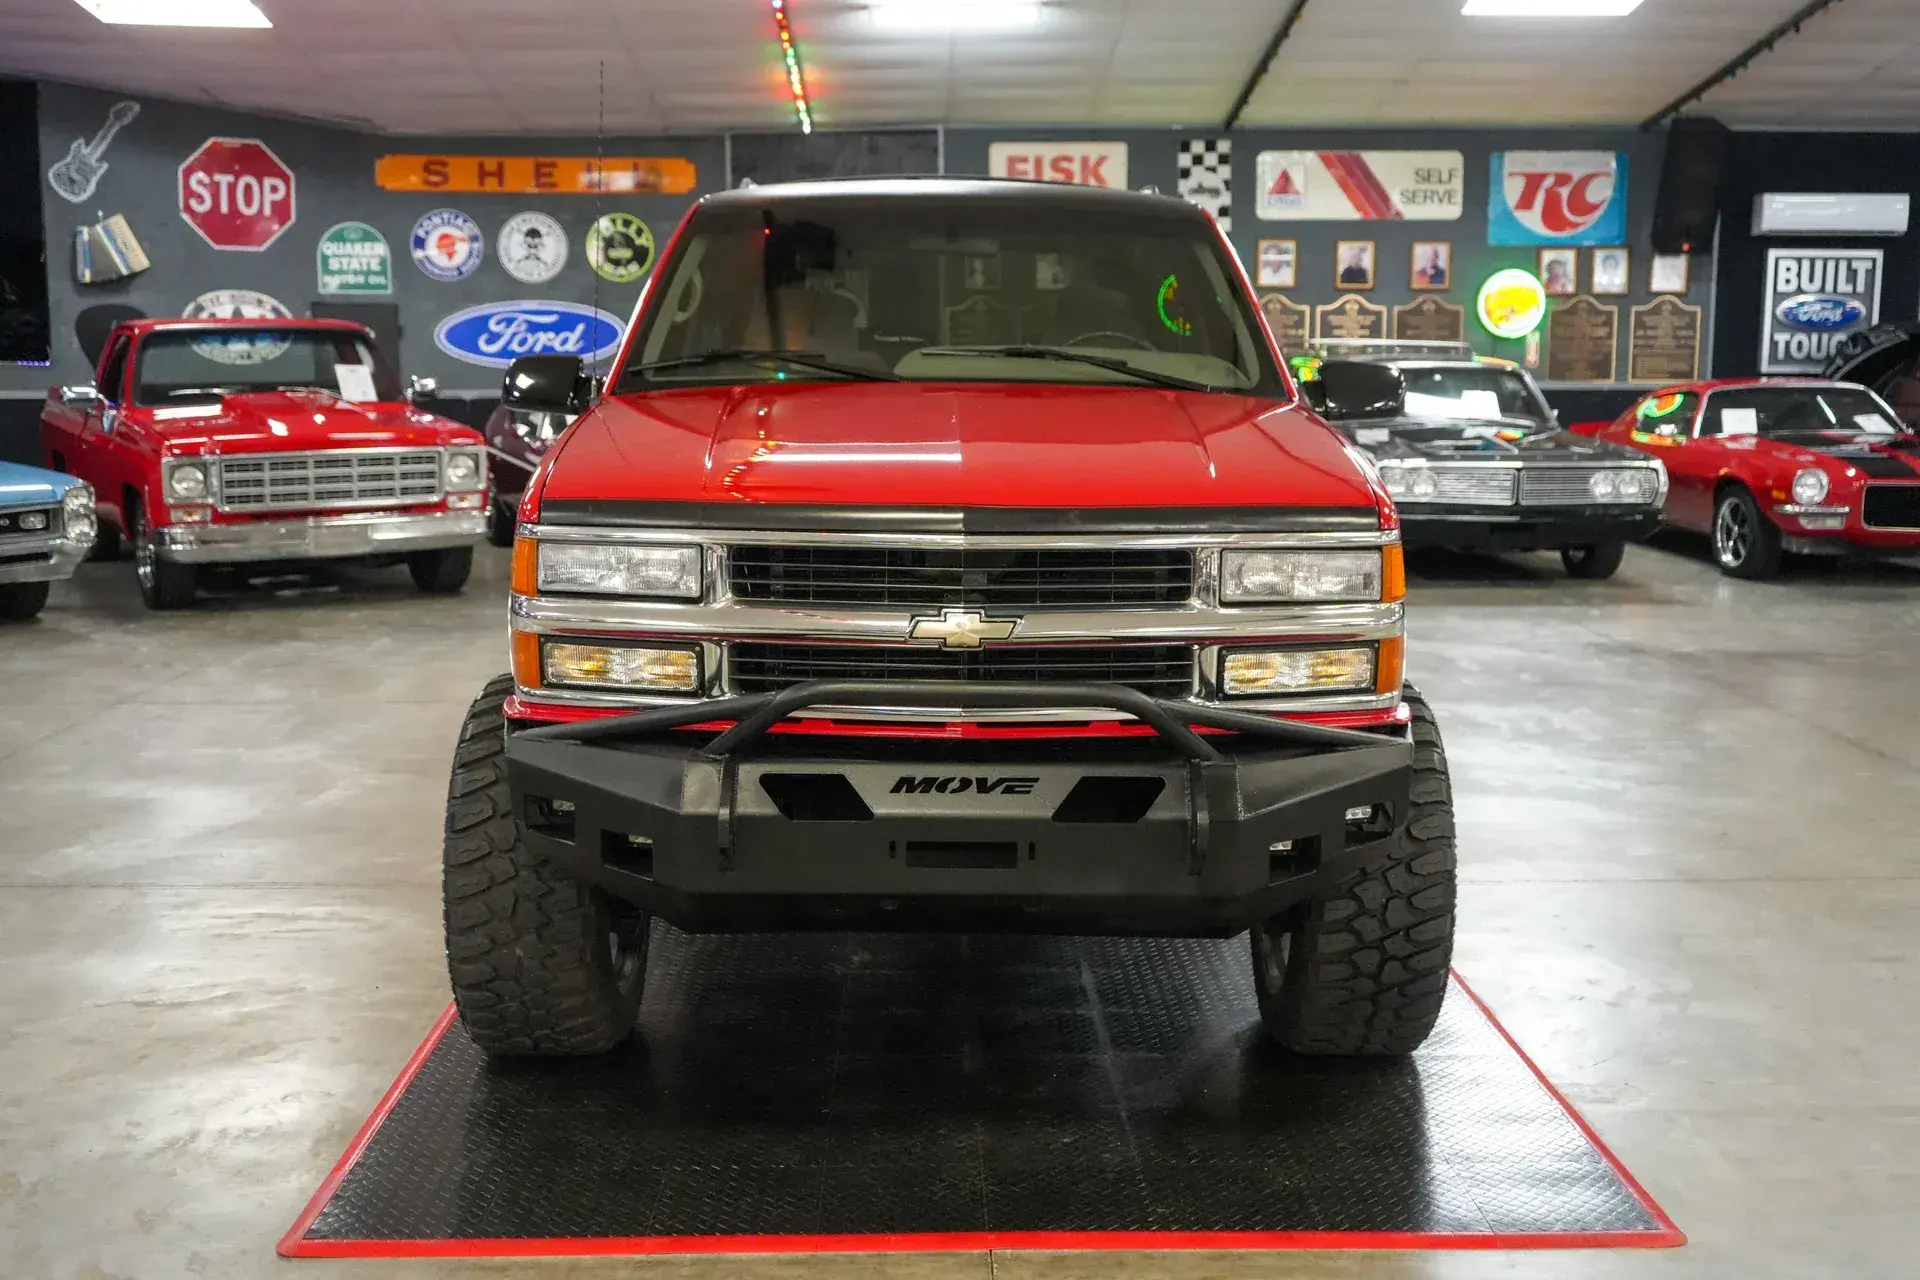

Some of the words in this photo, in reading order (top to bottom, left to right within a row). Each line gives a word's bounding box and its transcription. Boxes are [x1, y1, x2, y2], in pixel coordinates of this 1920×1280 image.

[1006, 153, 1110, 188] FISK
[1414, 168, 1460, 185] SELF
[188, 170, 287, 217] STOP
[1400, 189, 1460, 206] SERVE
[1508, 171, 1612, 232] RC
[328, 256, 382, 272] STATE
[1775, 258, 1874, 294] BUILT
[1797, 301, 1844, 323] Ford
[477, 312, 587, 354] Ford
[1773, 332, 1849, 361] TOUG
[889, 776, 1041, 795] MOVE
